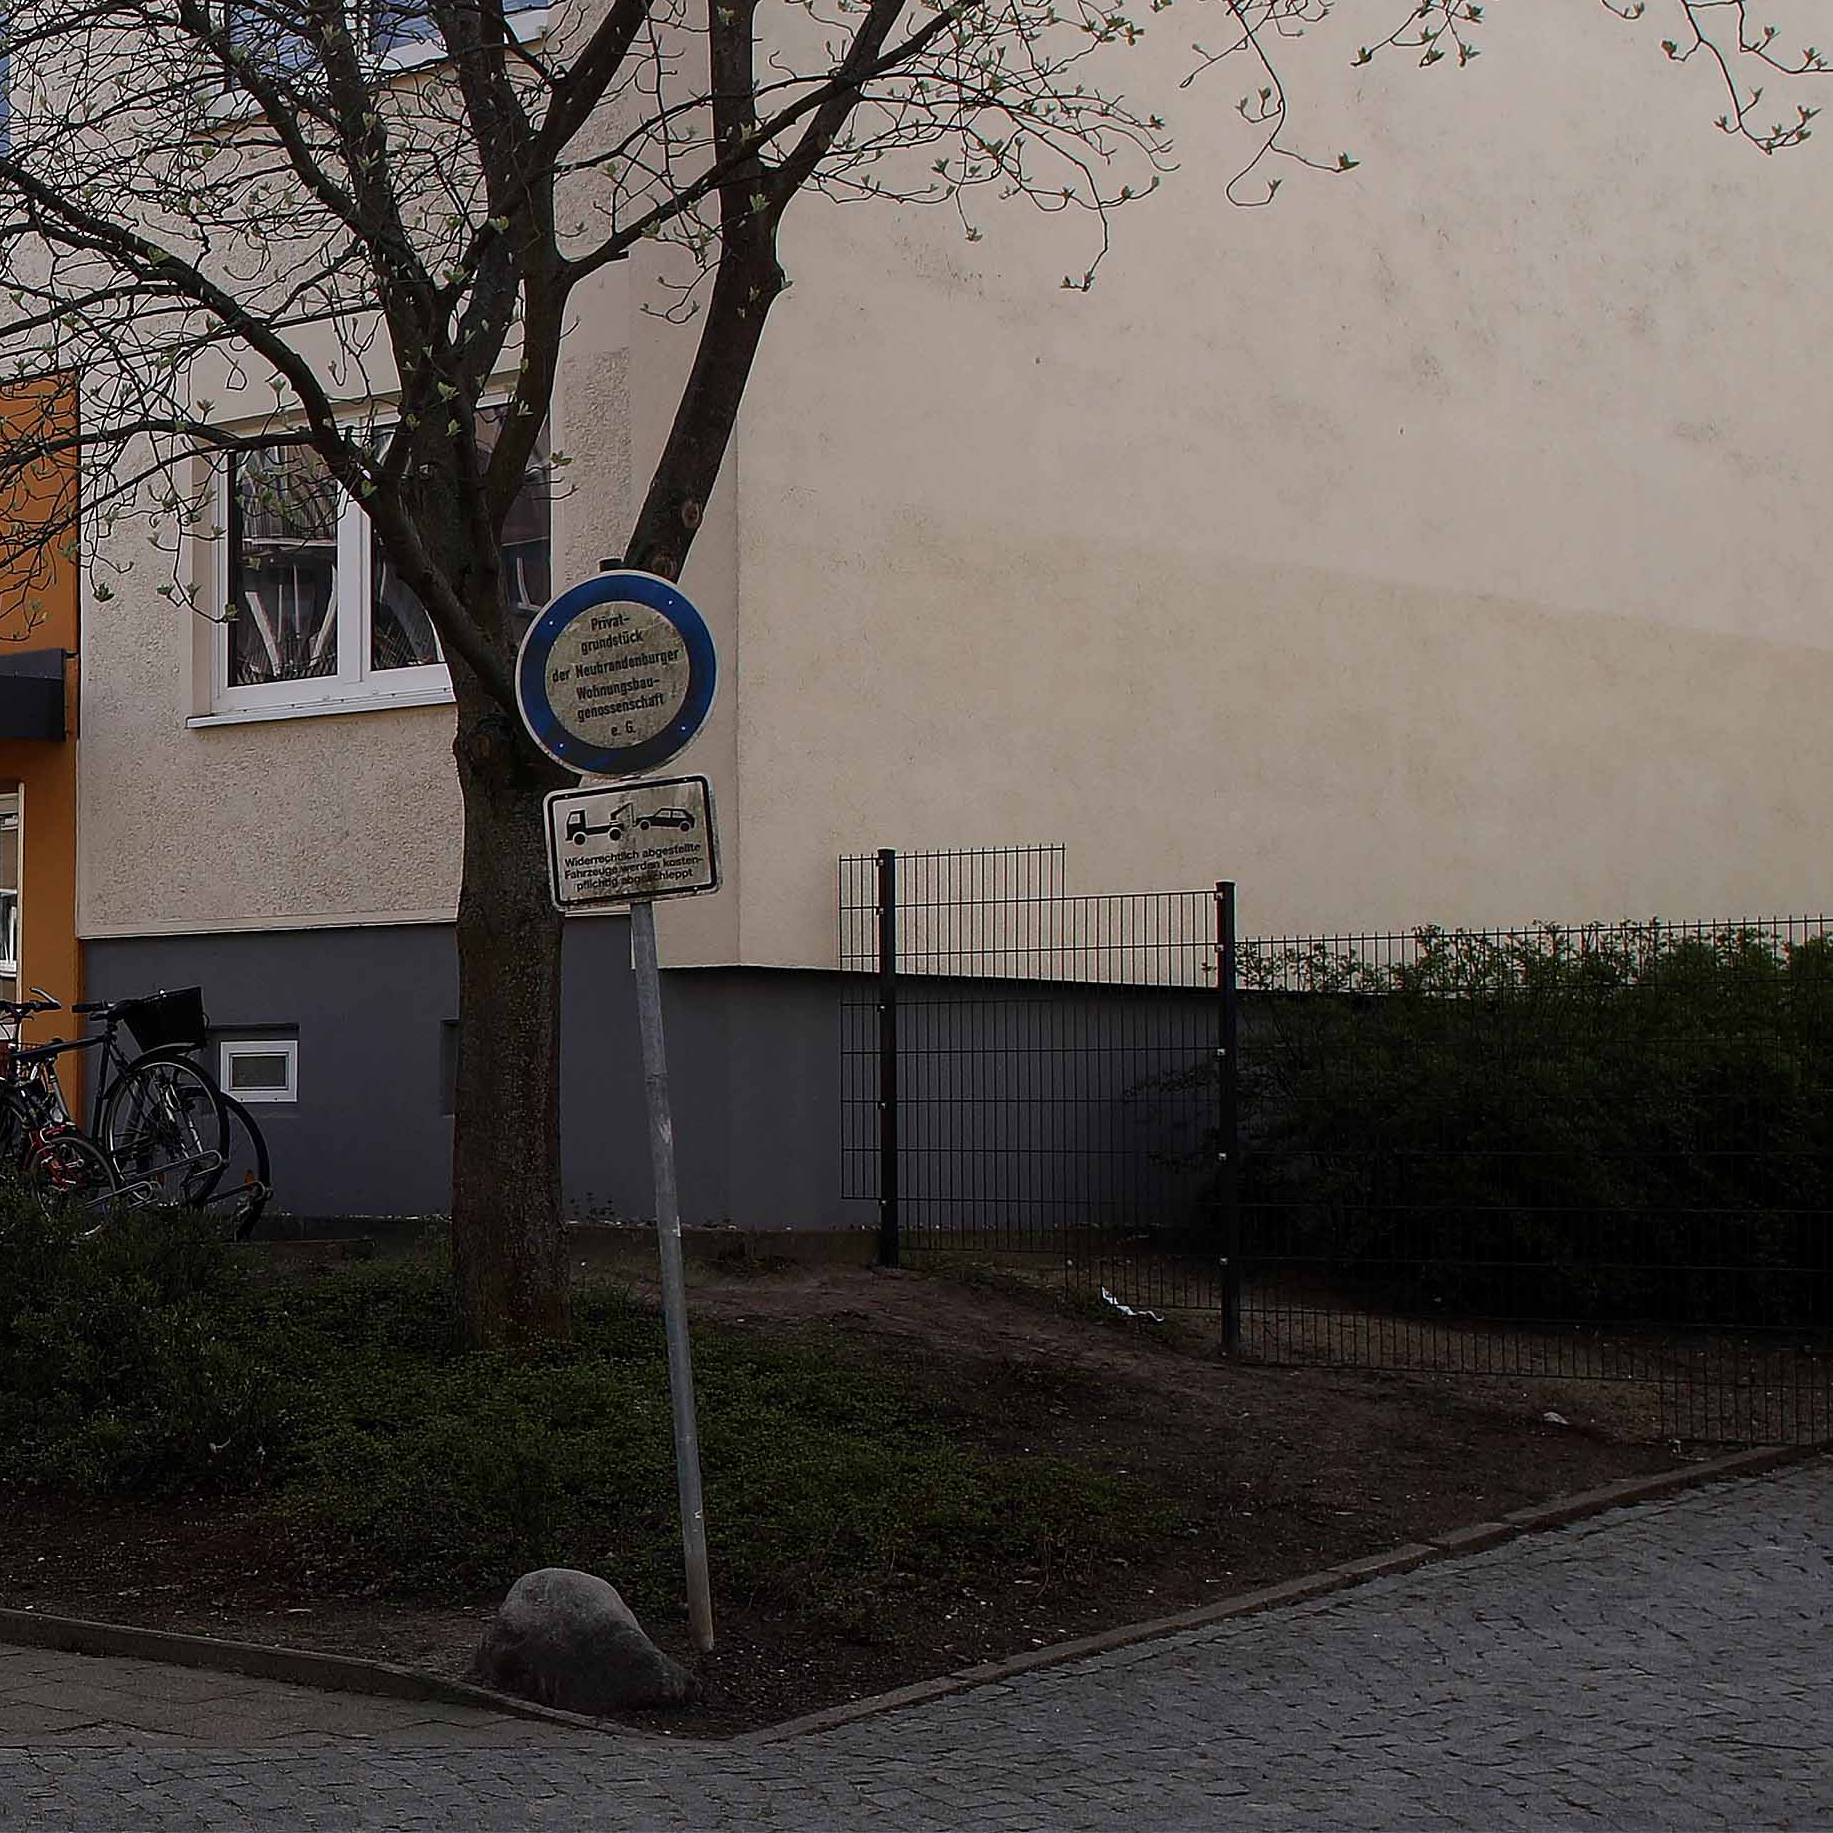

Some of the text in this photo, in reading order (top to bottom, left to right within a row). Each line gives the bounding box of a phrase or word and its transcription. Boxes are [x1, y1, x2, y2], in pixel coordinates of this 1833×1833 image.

[590, 613, 630, 631] Privat-
[580, 629, 644, 655] grundstück
[551, 648, 679, 682] der Neubrandenburger
[576, 677, 660, 700] Wohnungsbau-
[577, 692, 664, 723] genossenschaft
